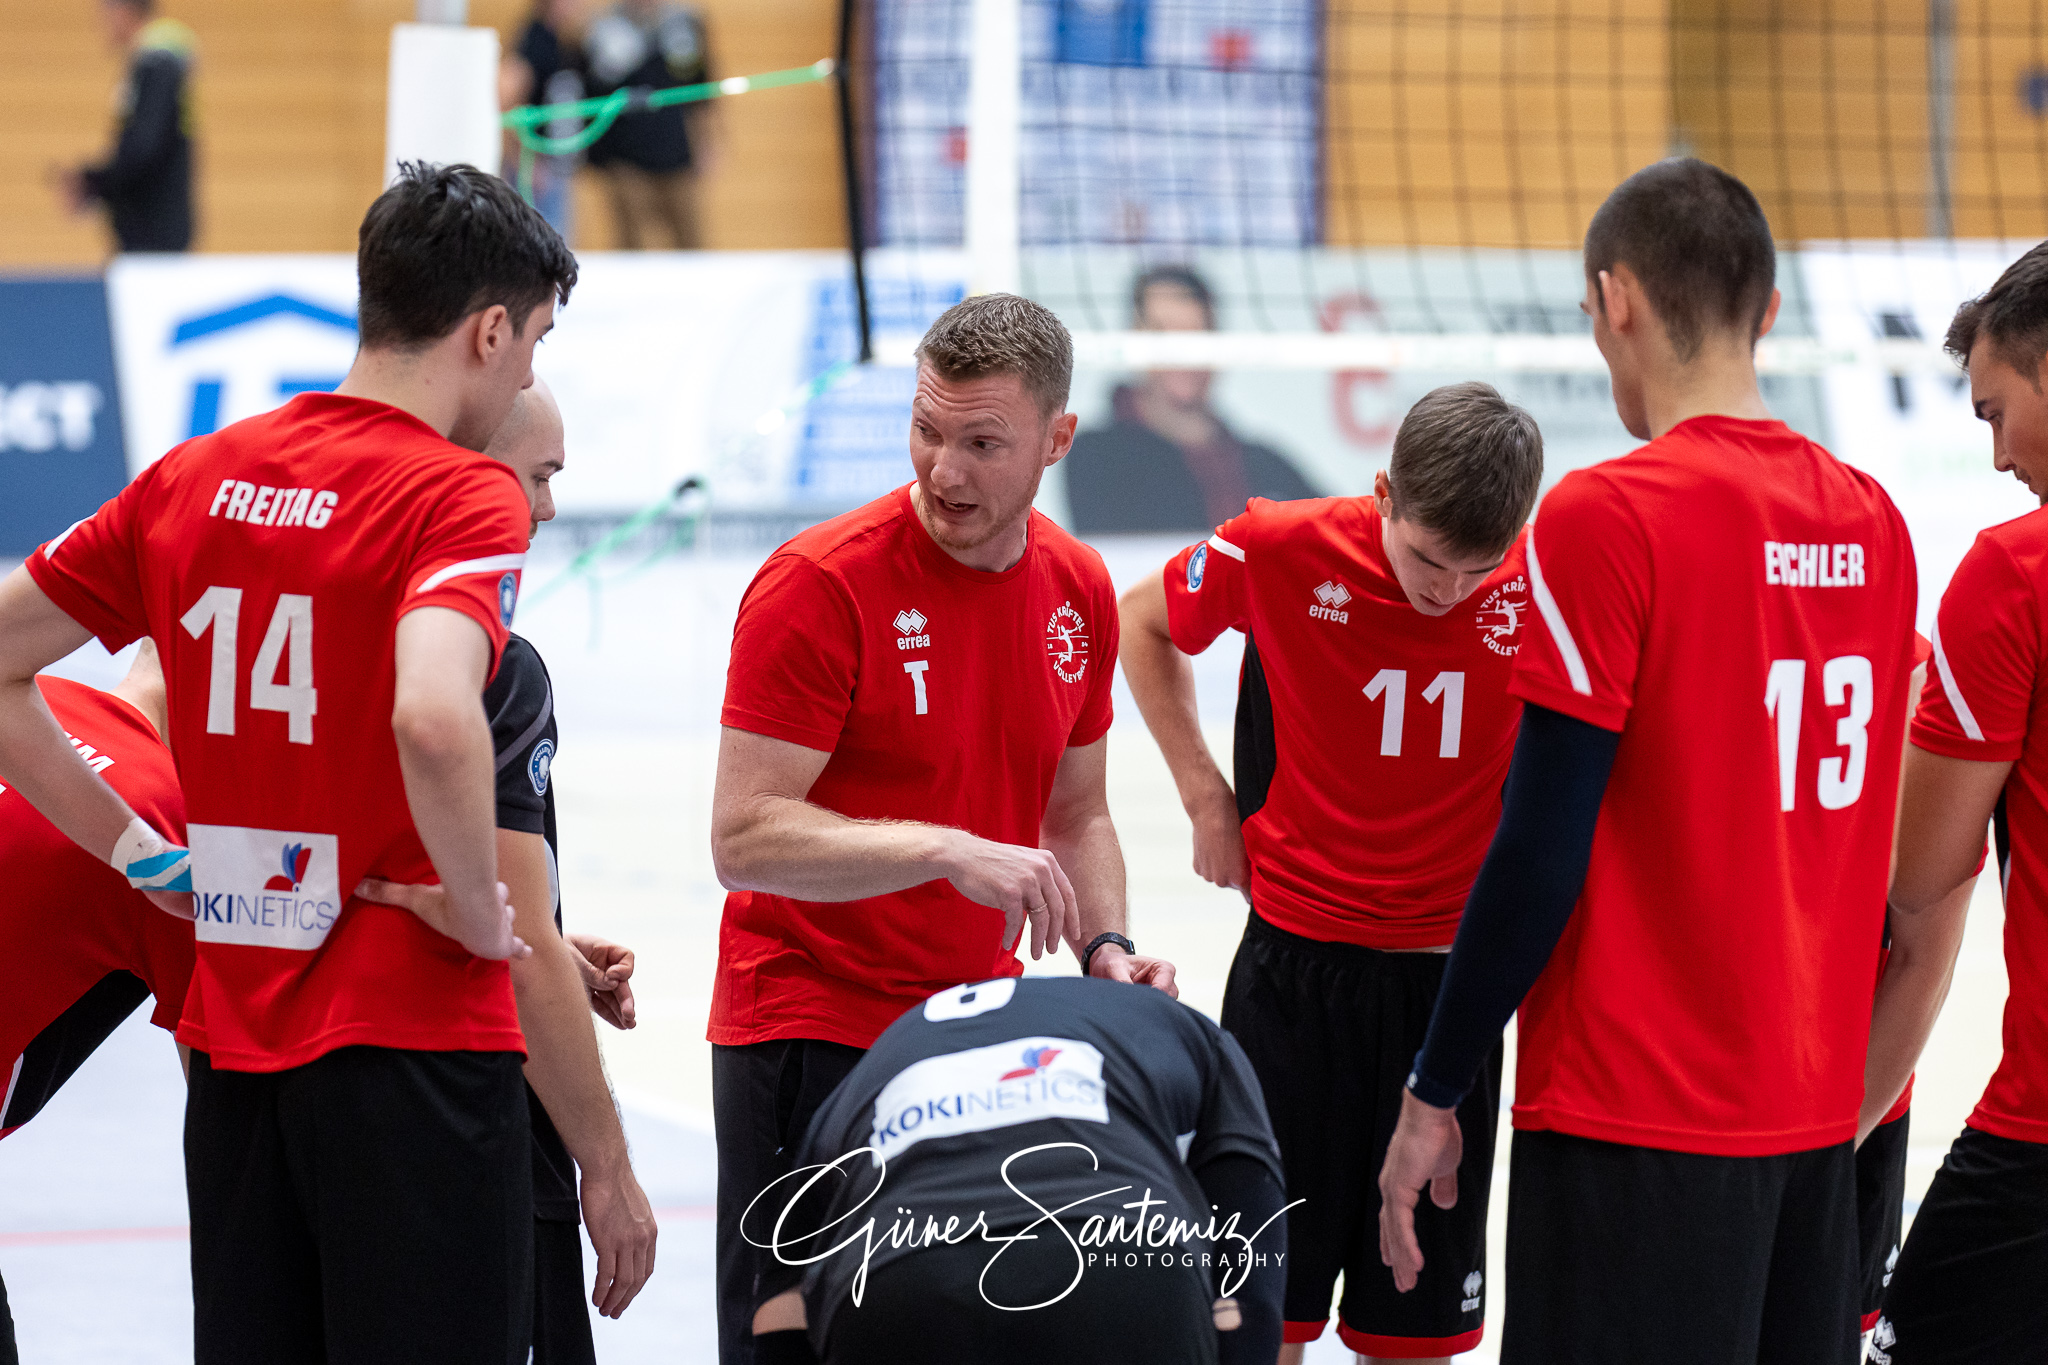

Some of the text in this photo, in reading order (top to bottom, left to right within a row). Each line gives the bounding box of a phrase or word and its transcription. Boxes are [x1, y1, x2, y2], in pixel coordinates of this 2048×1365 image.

[208, 479, 339, 529] FREITAG
[1763, 541, 1865, 587] EICHLER
[1046, 604, 1085, 633] TUS KRIFTEL
[1309, 604, 1349, 625] errea
[1480, 589, 1500, 608] TUS
[179, 585, 317, 745] 14
[897, 634, 930, 650] errea
[903, 660, 929, 715] T
[1362, 668, 1465, 758] 11
[1763, 655, 1873, 812] 13
[879, 1074, 1100, 1146] KOKINETICS
